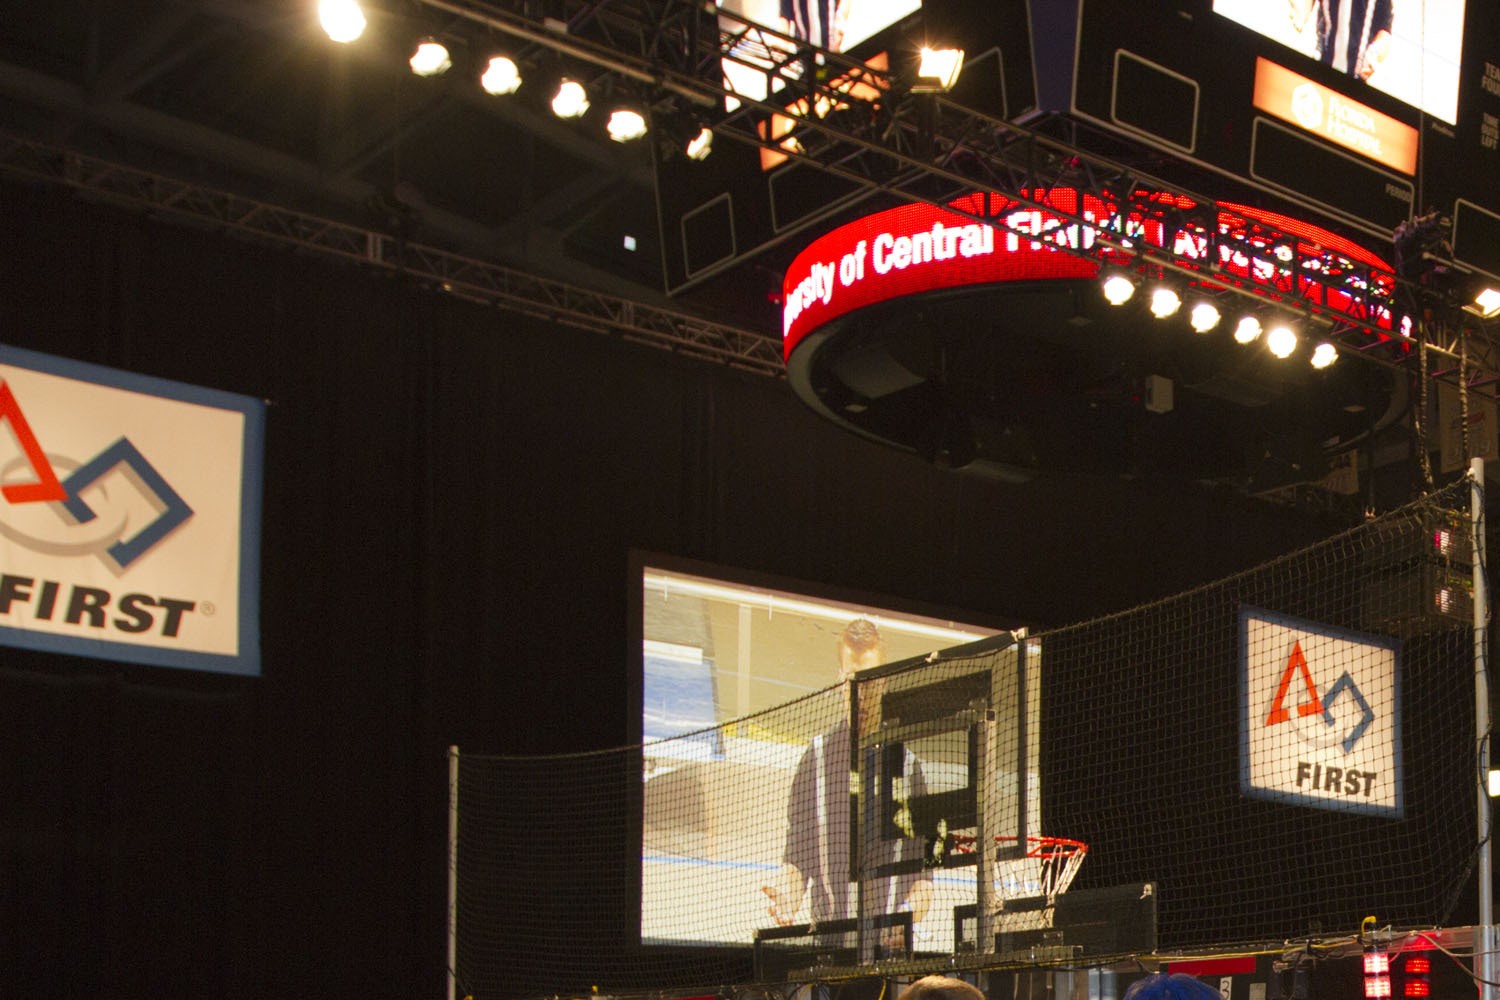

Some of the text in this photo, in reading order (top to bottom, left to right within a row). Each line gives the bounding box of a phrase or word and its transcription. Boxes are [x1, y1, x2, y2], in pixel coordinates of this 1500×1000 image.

[839, 239, 868, 288] of
[873, 222, 994, 275] Central
[0, 574, 196, 638] FIRST
[1296, 762, 1377, 797] FIRST
